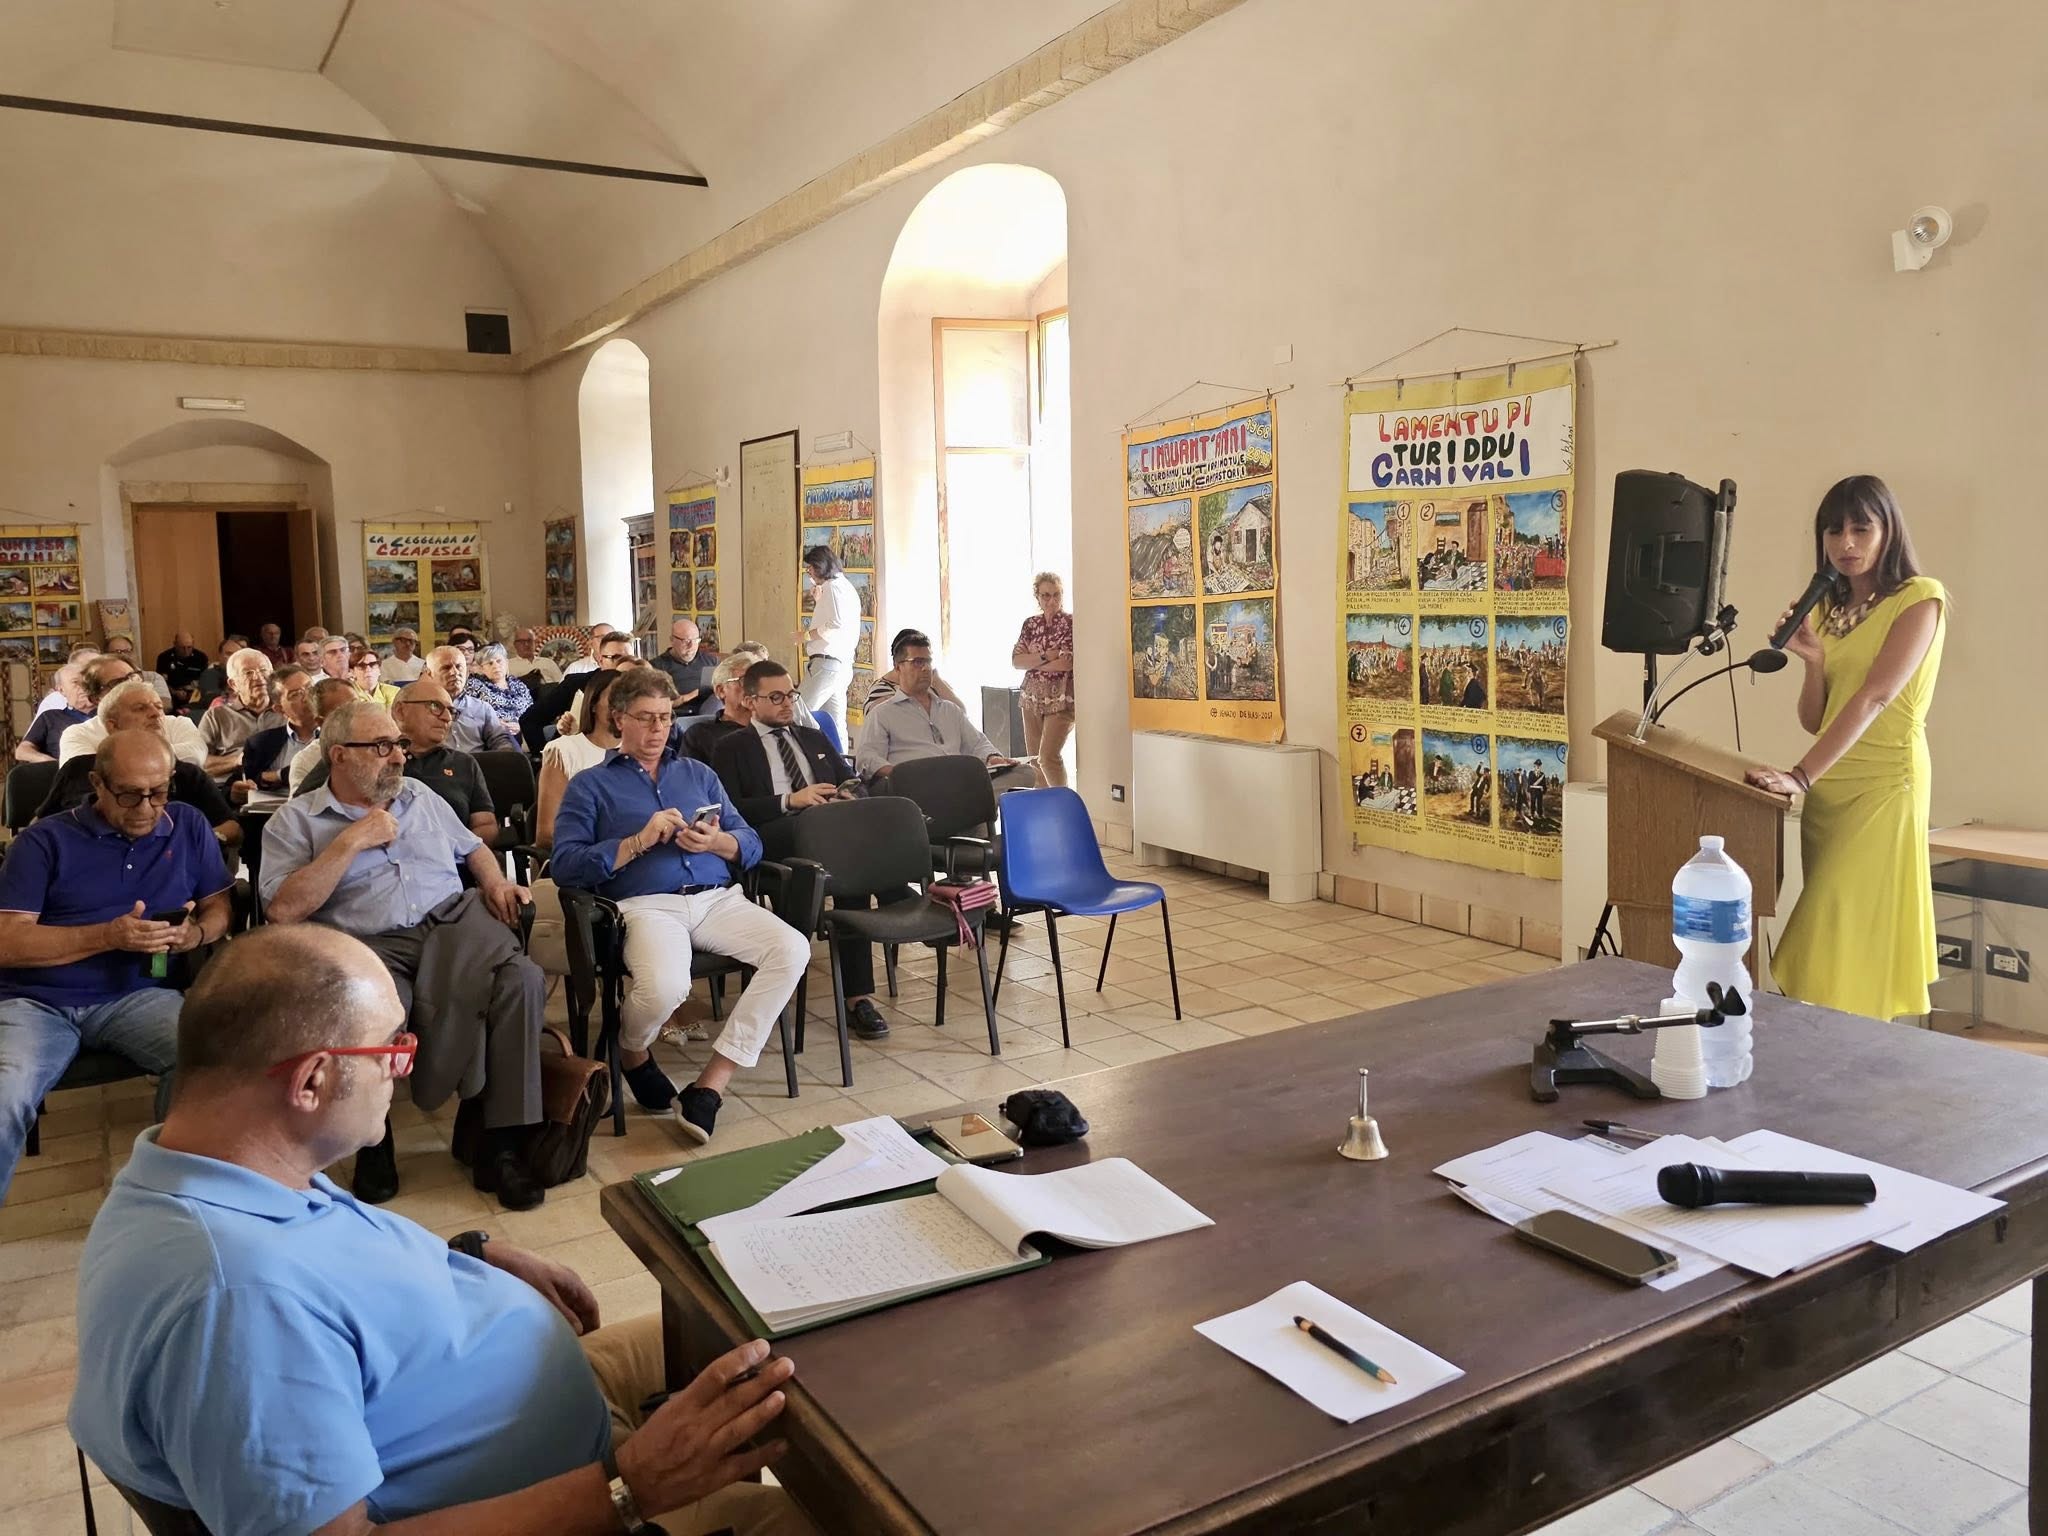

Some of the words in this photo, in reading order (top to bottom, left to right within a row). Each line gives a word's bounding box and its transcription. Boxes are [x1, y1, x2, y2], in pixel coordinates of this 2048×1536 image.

[1378, 407, 1499, 443] LAMENTU
[1506, 395, 1532, 430] PI
[1141, 424, 1247, 473] CINQUANT'ANNI
[1371, 438, 1530, 488] CARNIVALI
[1393, 431, 1515, 467] TURIDDU
[376, 543, 472, 556] COLAPESCE
